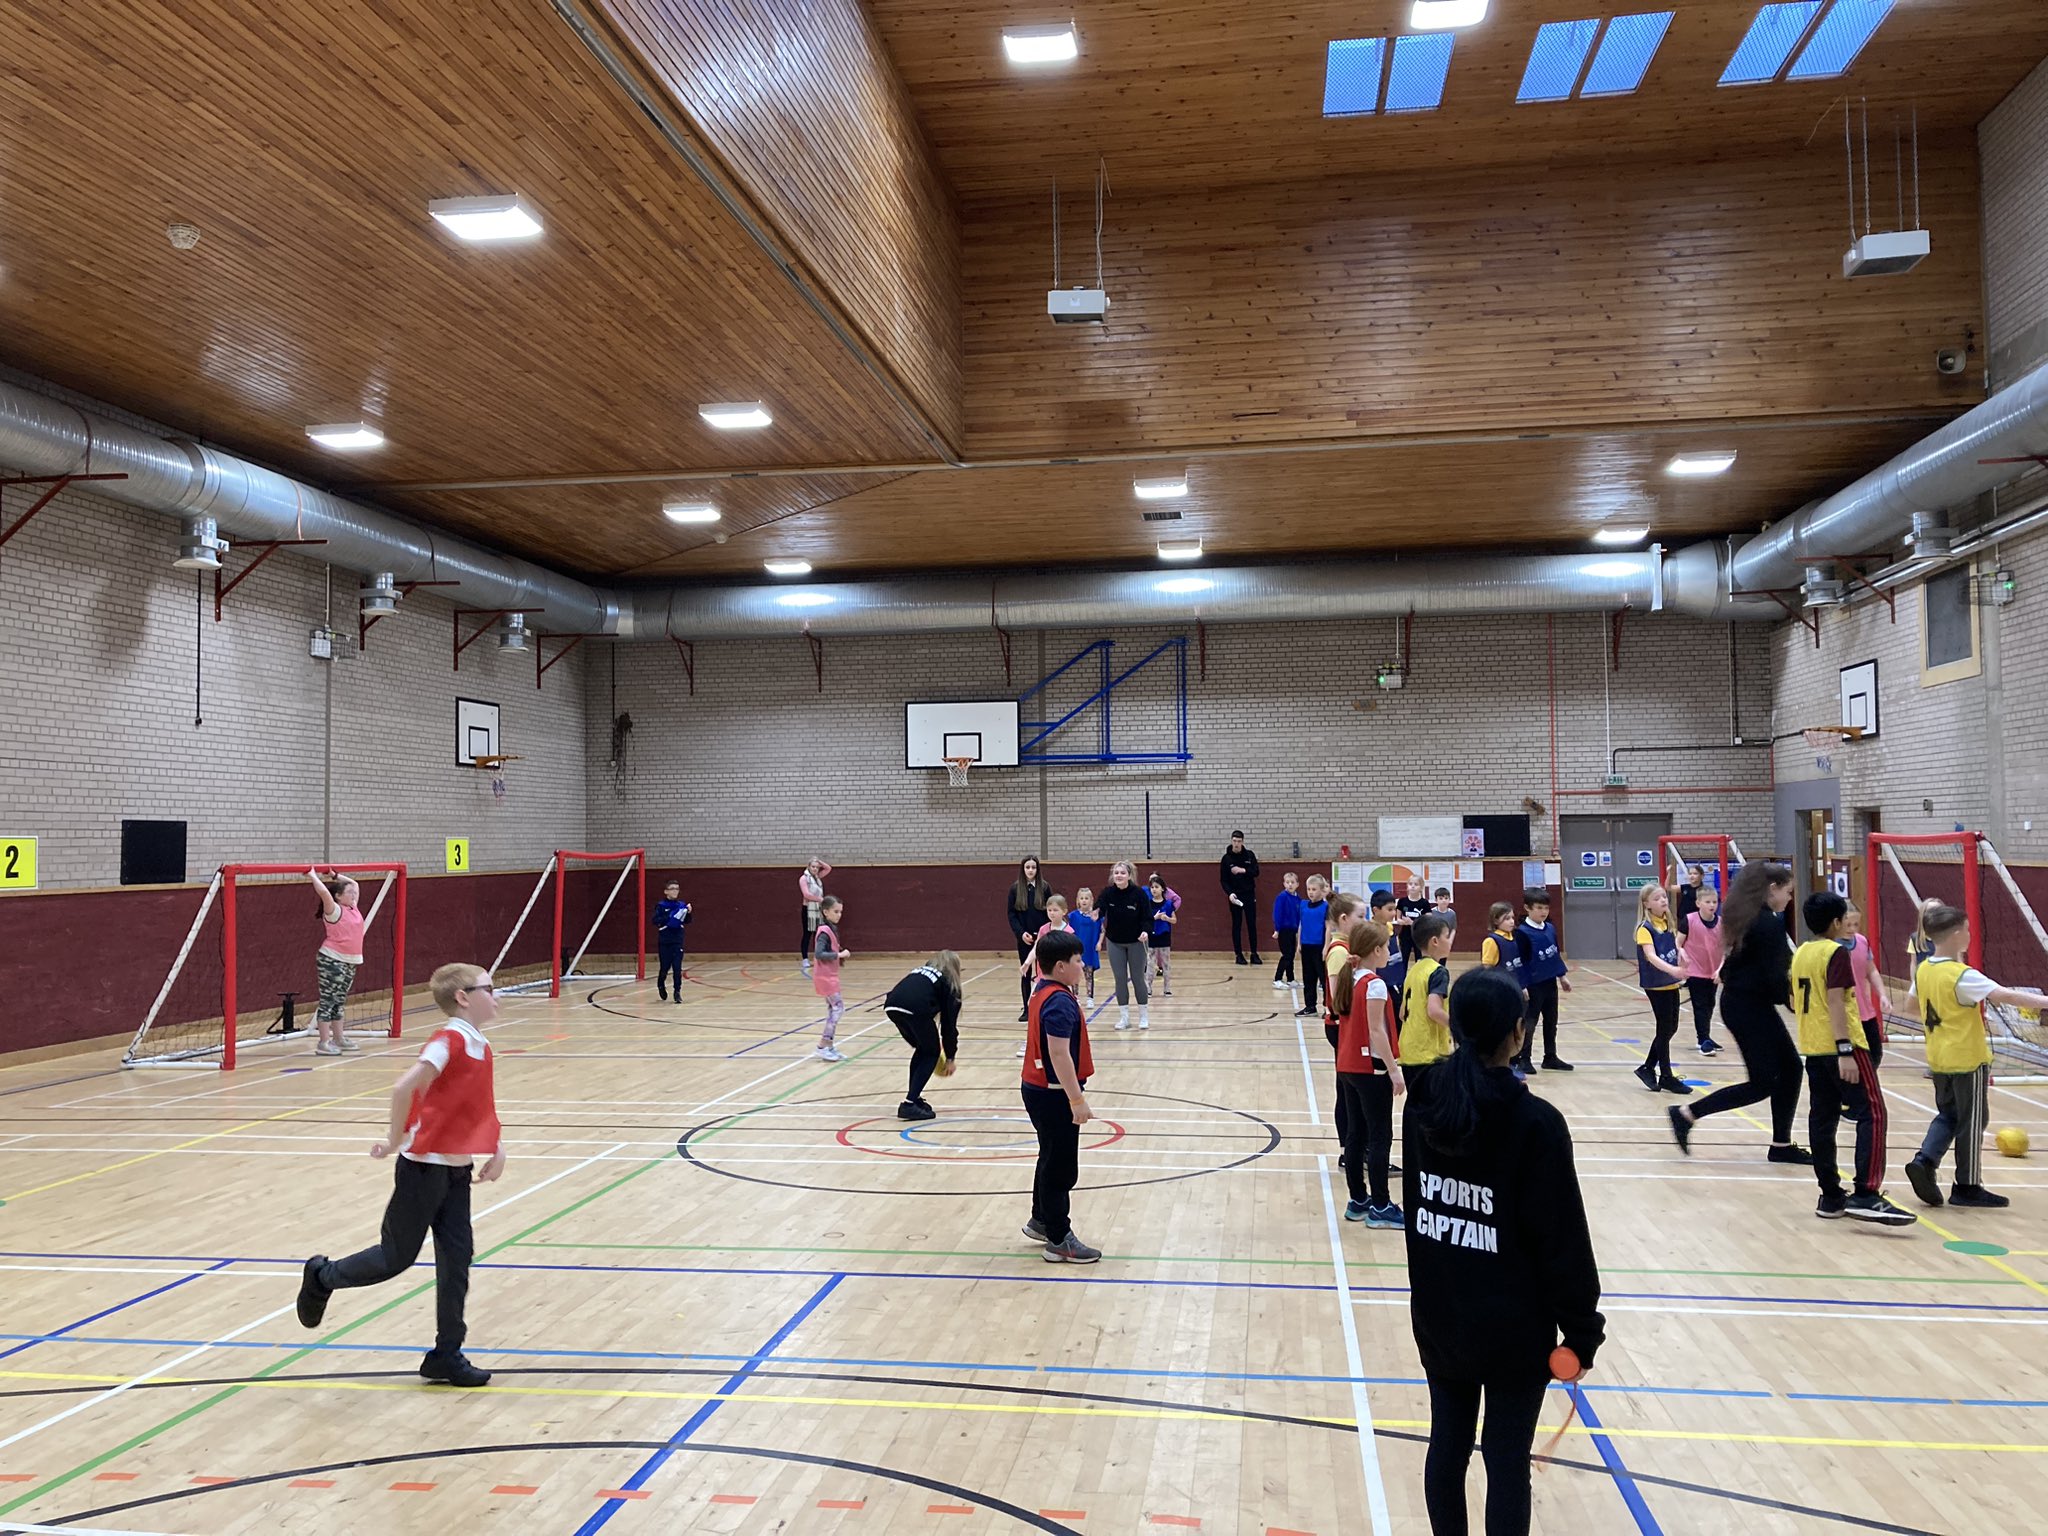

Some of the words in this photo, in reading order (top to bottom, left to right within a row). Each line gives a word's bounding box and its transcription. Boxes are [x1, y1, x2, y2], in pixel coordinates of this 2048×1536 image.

[5, 845, 19, 878] 2
[455, 844, 461, 866] 3
[1798, 978, 1811, 1014] 7
[1925, 998, 1942, 1033] 4
[1419, 1171, 1494, 1215] SPORTS
[1416, 1206, 1499, 1254] CAPTAIN
